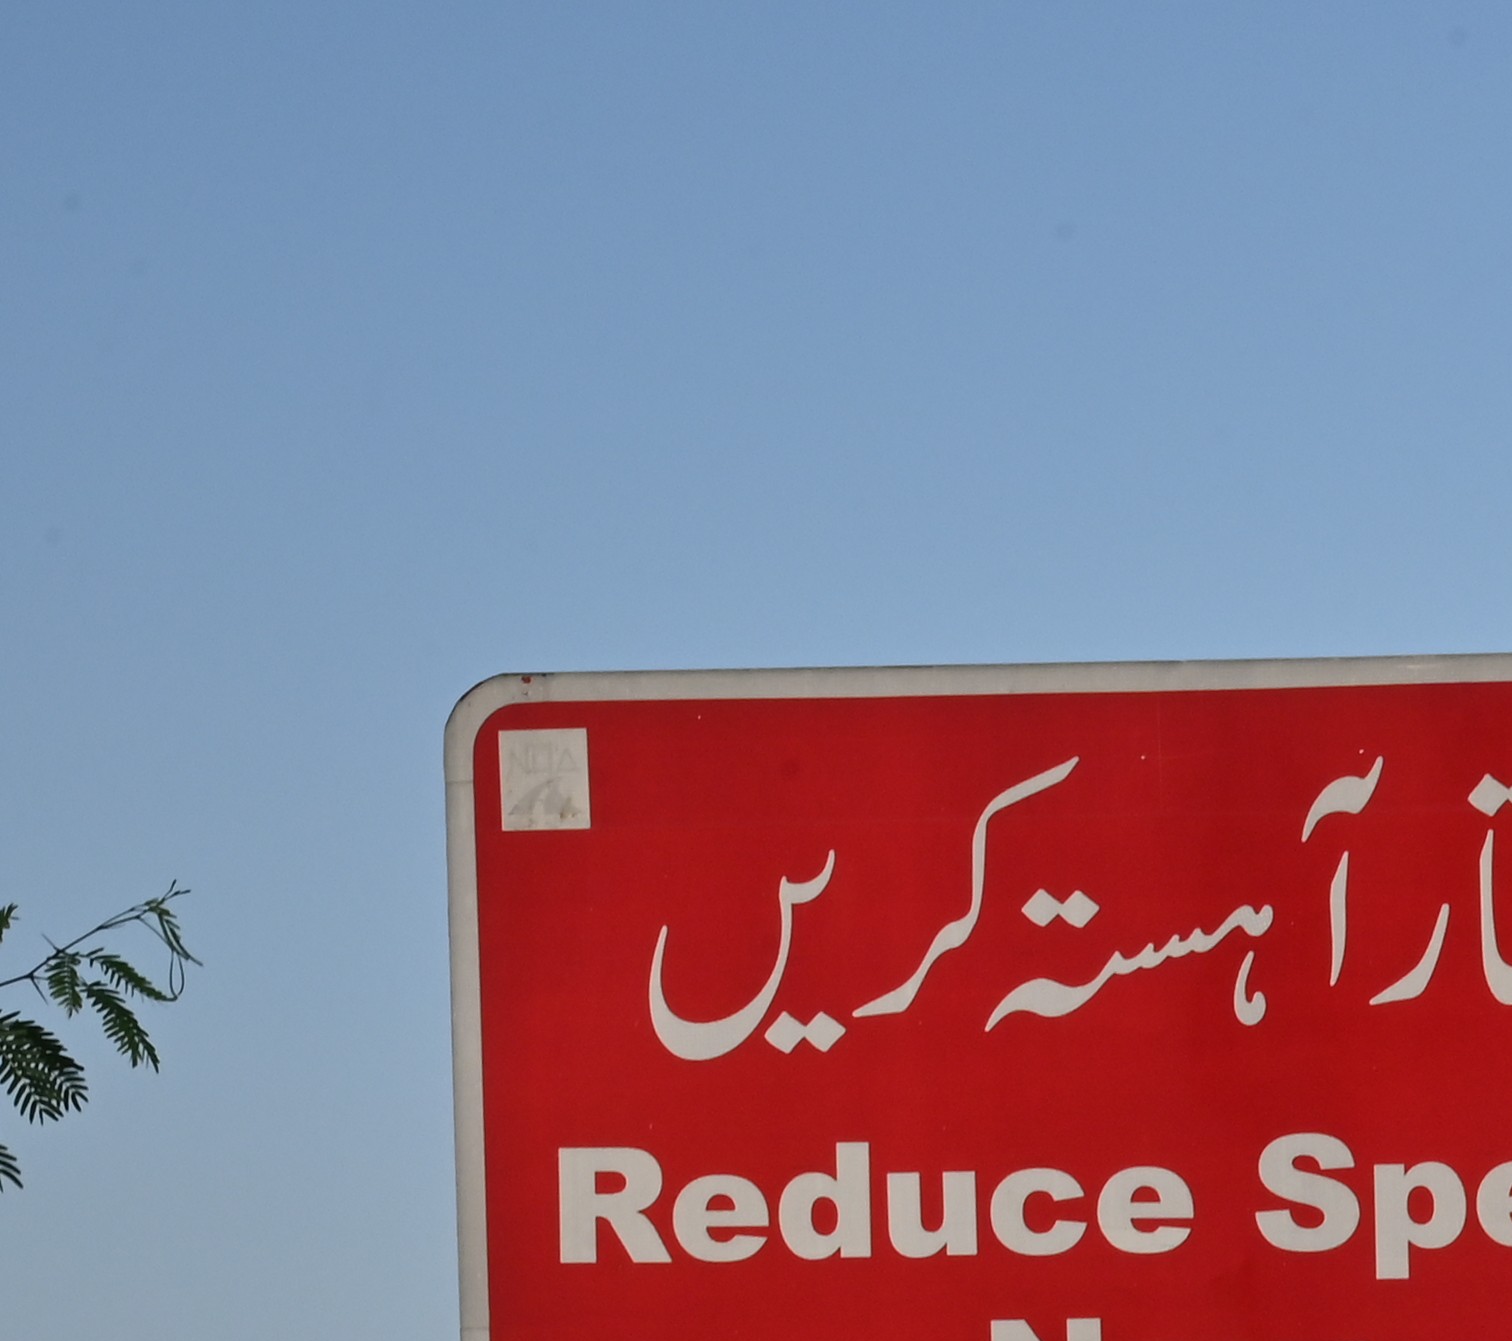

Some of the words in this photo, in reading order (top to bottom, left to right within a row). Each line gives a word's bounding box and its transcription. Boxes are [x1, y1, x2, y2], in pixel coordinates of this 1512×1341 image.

[649, 755, 1079, 1062] کریں
[984, 755, 1387, 1030] آہستہ
[559, 1142, 1194, 1263] Reduce
